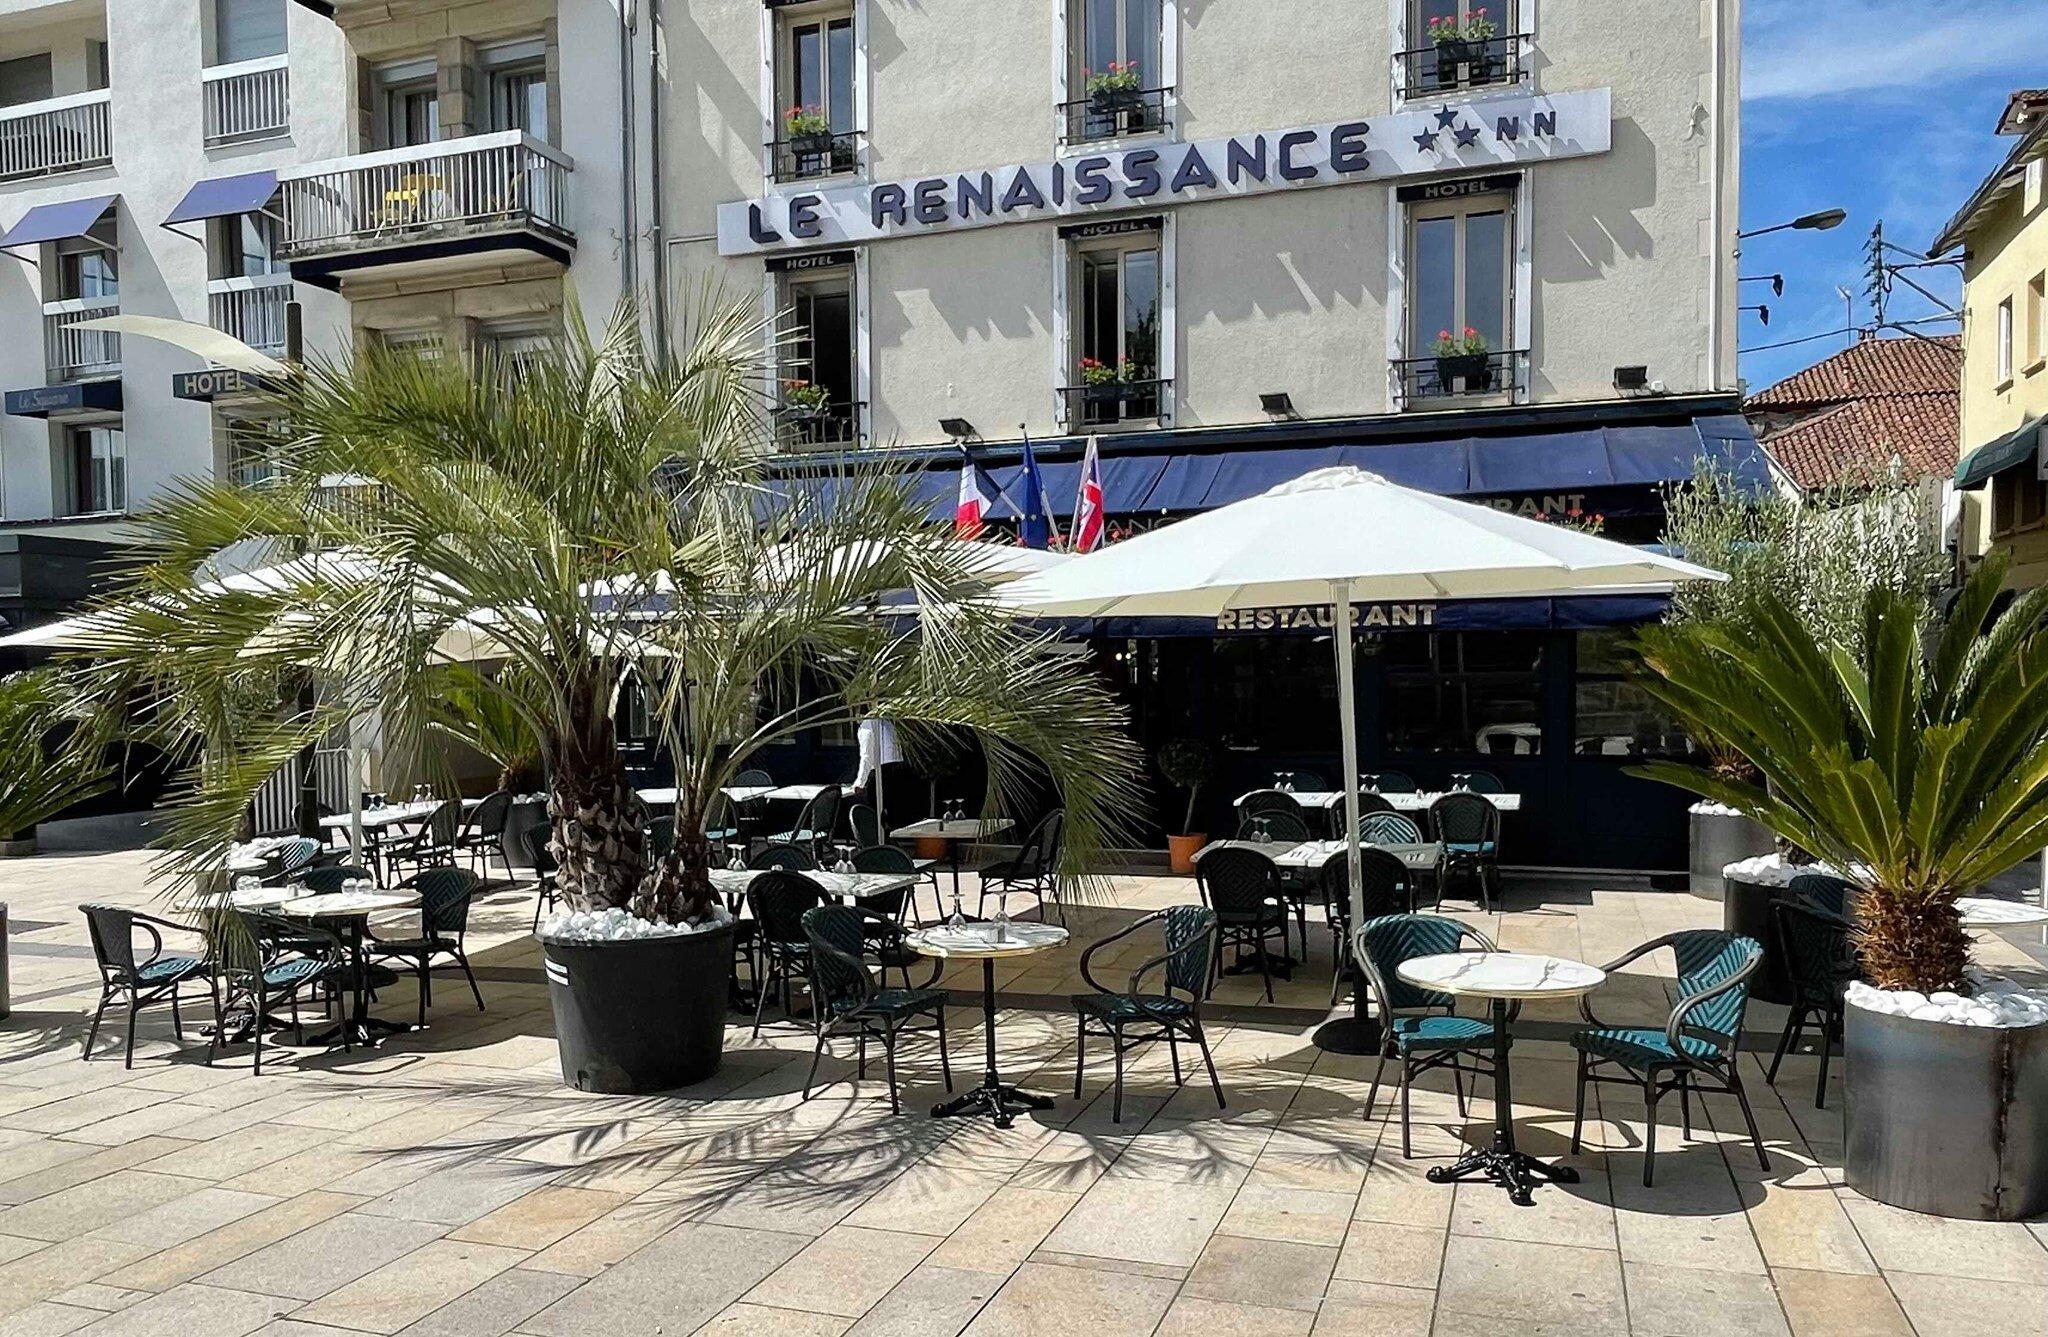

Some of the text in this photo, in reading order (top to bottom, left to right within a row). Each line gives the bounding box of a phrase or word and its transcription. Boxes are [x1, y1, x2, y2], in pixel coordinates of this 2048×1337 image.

[749, 194, 823, 244] LE
[871, 122, 1370, 229] RENAISSANCE
[1425, 181, 1490, 198] HOTEL
[1083, 222, 1138, 235] HOTEL
[786, 256, 834, 270] HOTEL
[184, 371, 246, 395] HOTEL
